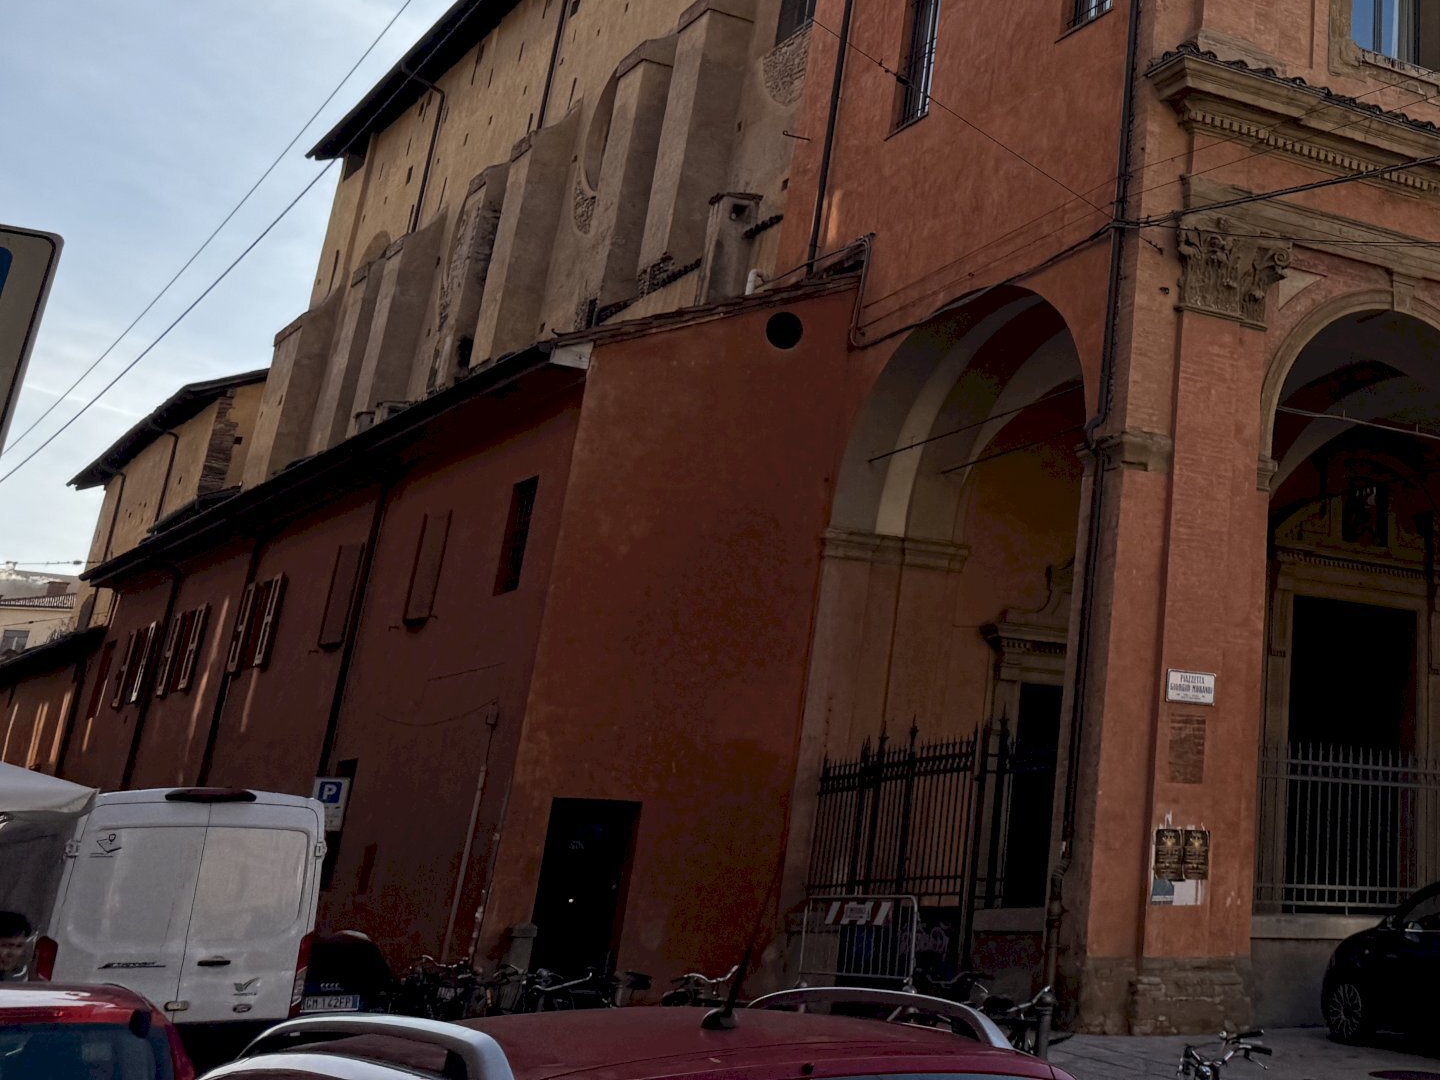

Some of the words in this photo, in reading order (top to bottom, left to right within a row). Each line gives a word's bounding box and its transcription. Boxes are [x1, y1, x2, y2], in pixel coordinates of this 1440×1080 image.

[1180, 674, 1205, 684] PIAZZETTA
[1170, 682, 1190, 692] GIORGIO
[1192, 685, 1212, 694] MORANDI
[322, 783, 338, 800] P
